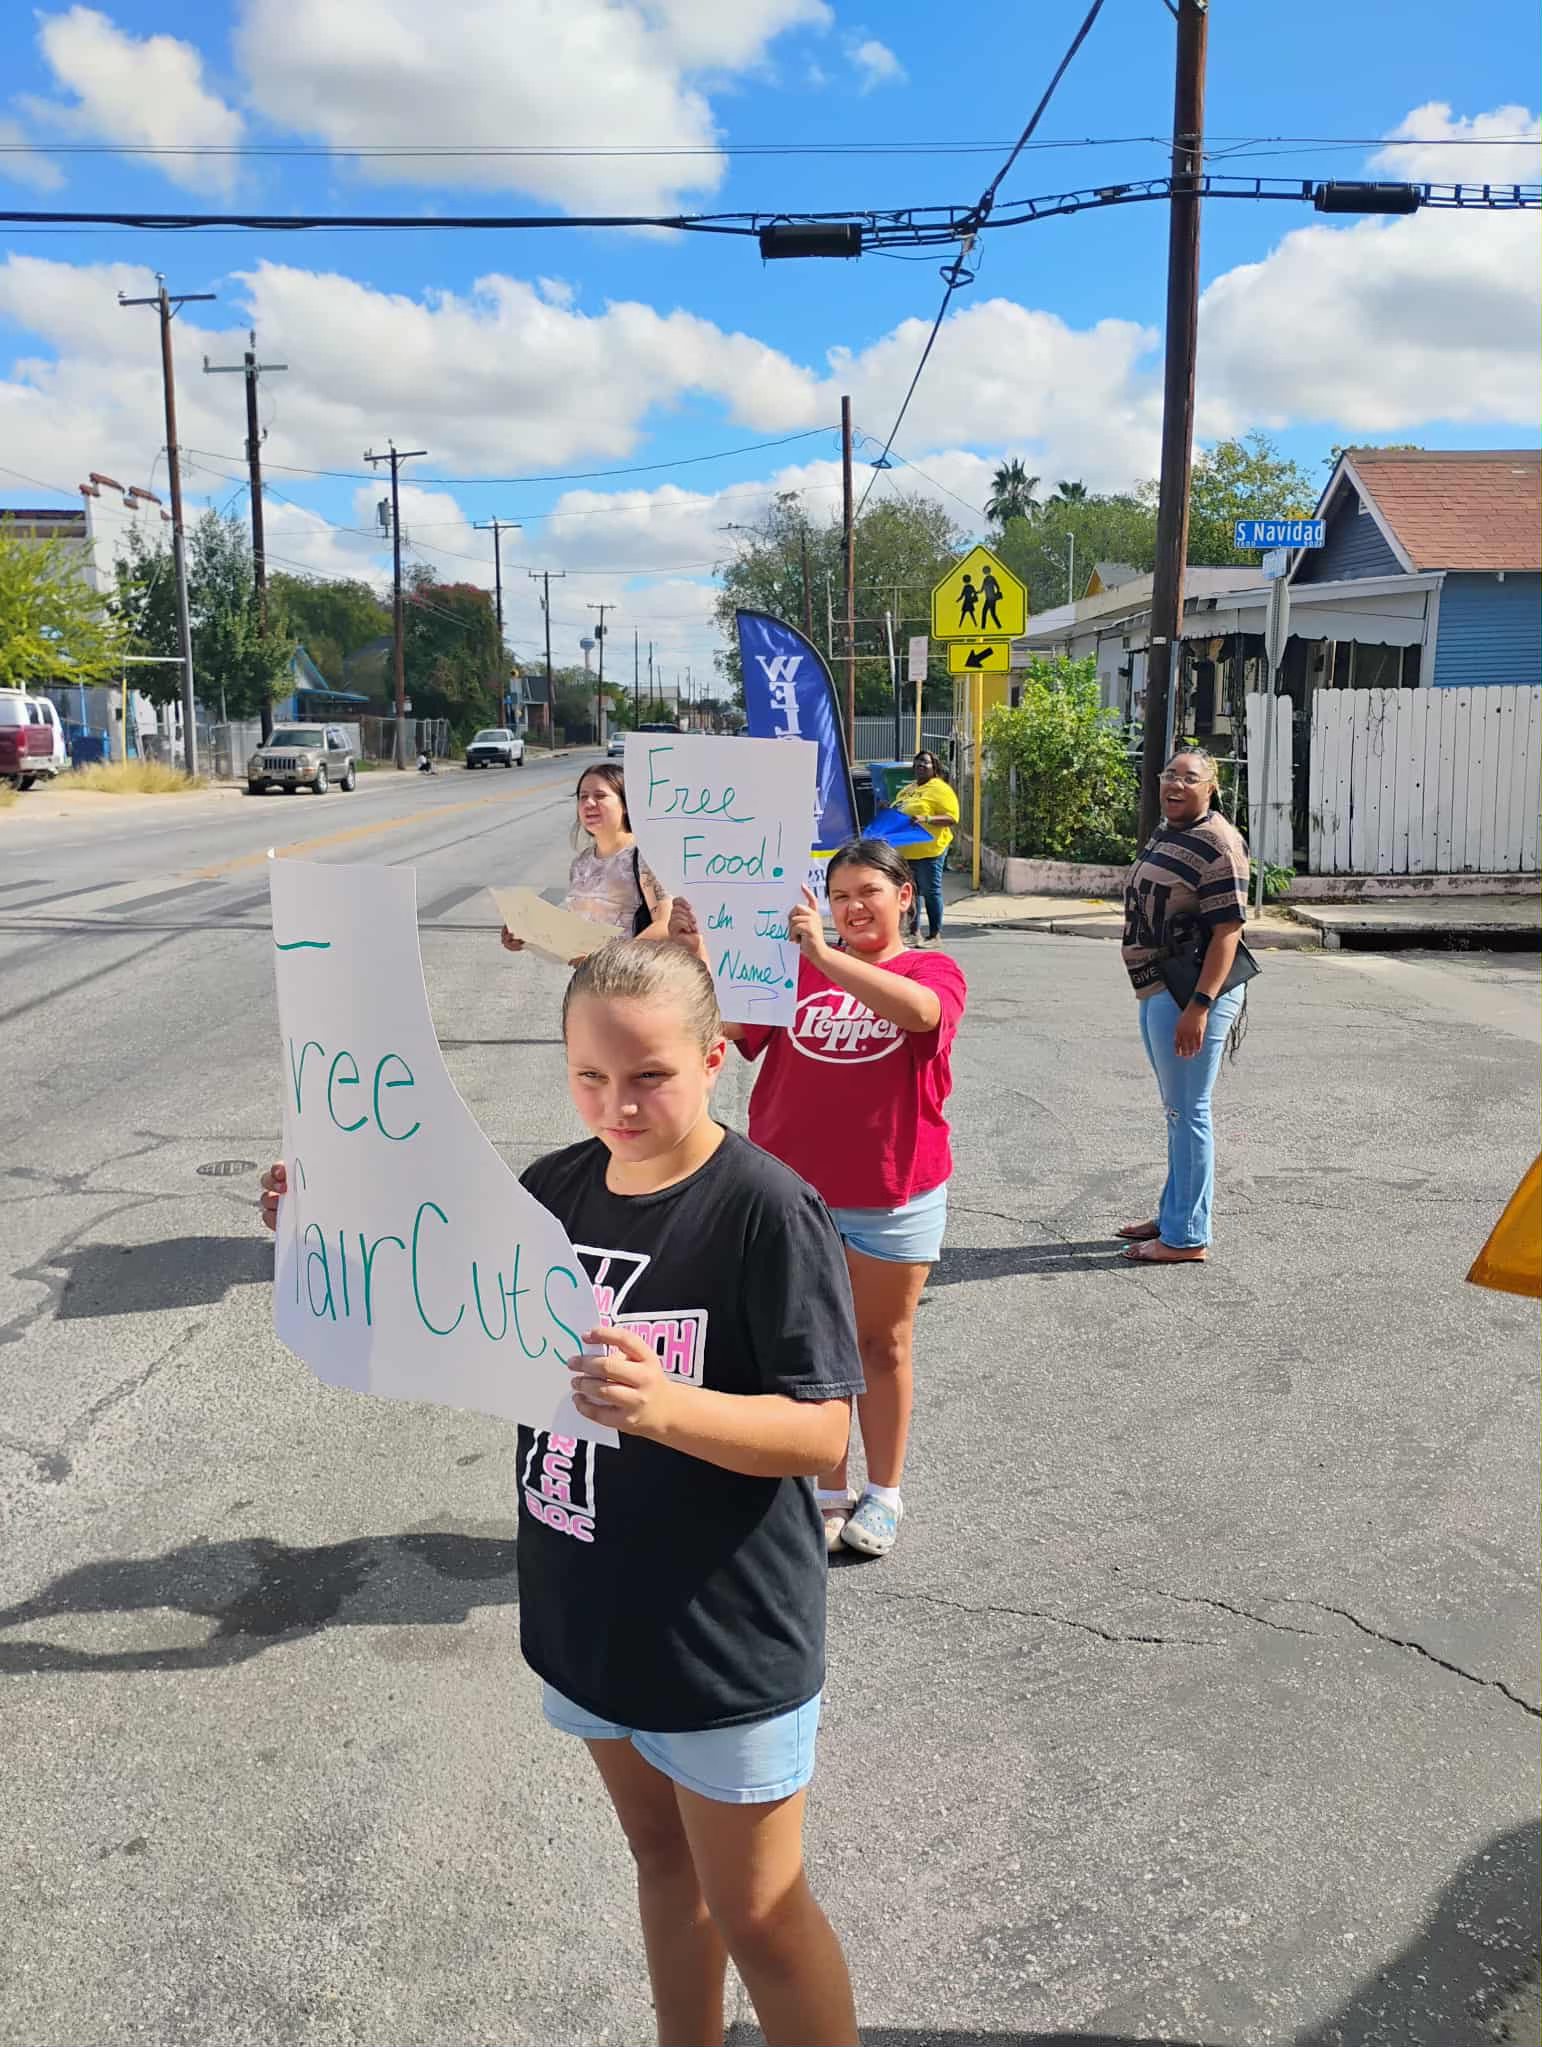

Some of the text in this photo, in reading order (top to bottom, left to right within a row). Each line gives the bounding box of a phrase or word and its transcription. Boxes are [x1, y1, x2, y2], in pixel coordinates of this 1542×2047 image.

[1236, 521, 1324, 541] S Navidad
[648, 746, 756, 823] Free
[682, 821, 785, 879] Food!
[288, 1037, 421, 1141] ree
